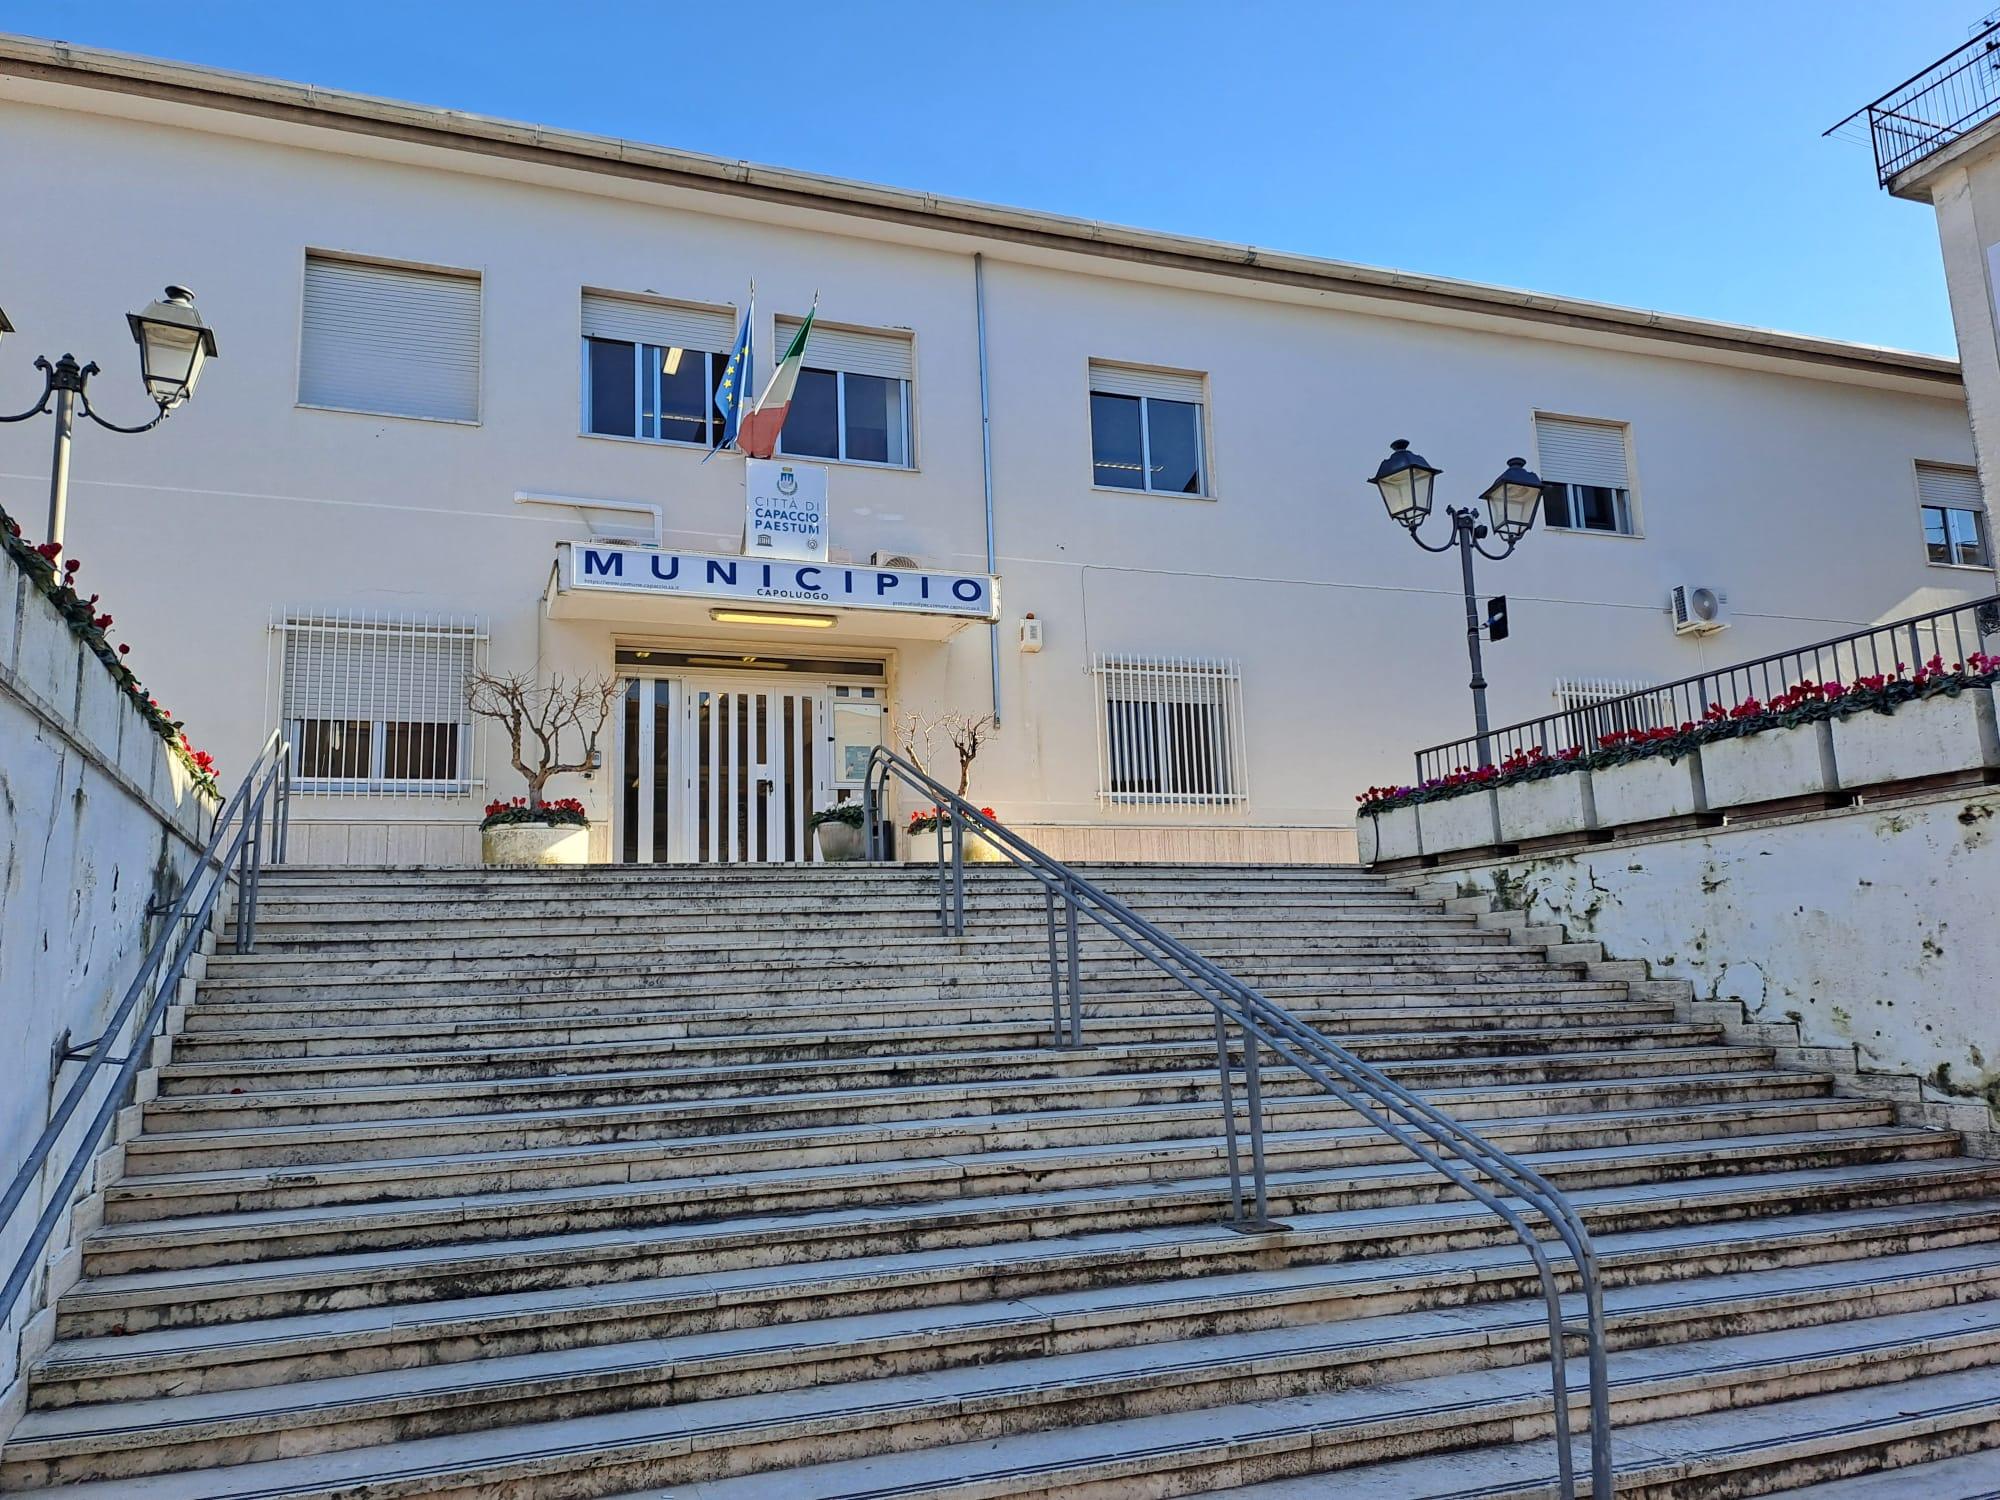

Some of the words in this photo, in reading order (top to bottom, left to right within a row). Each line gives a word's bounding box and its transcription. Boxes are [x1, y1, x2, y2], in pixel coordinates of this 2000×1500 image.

[755, 496, 798, 510] CITTÀ
[805, 501, 819, 512] DI
[755, 508, 819, 523] CAPACCIO
[755, 520, 820, 534] PAESTUM
[584, 550, 982, 602] MUNICIPIO
[756, 588, 829, 600] CAPOLUOGO
